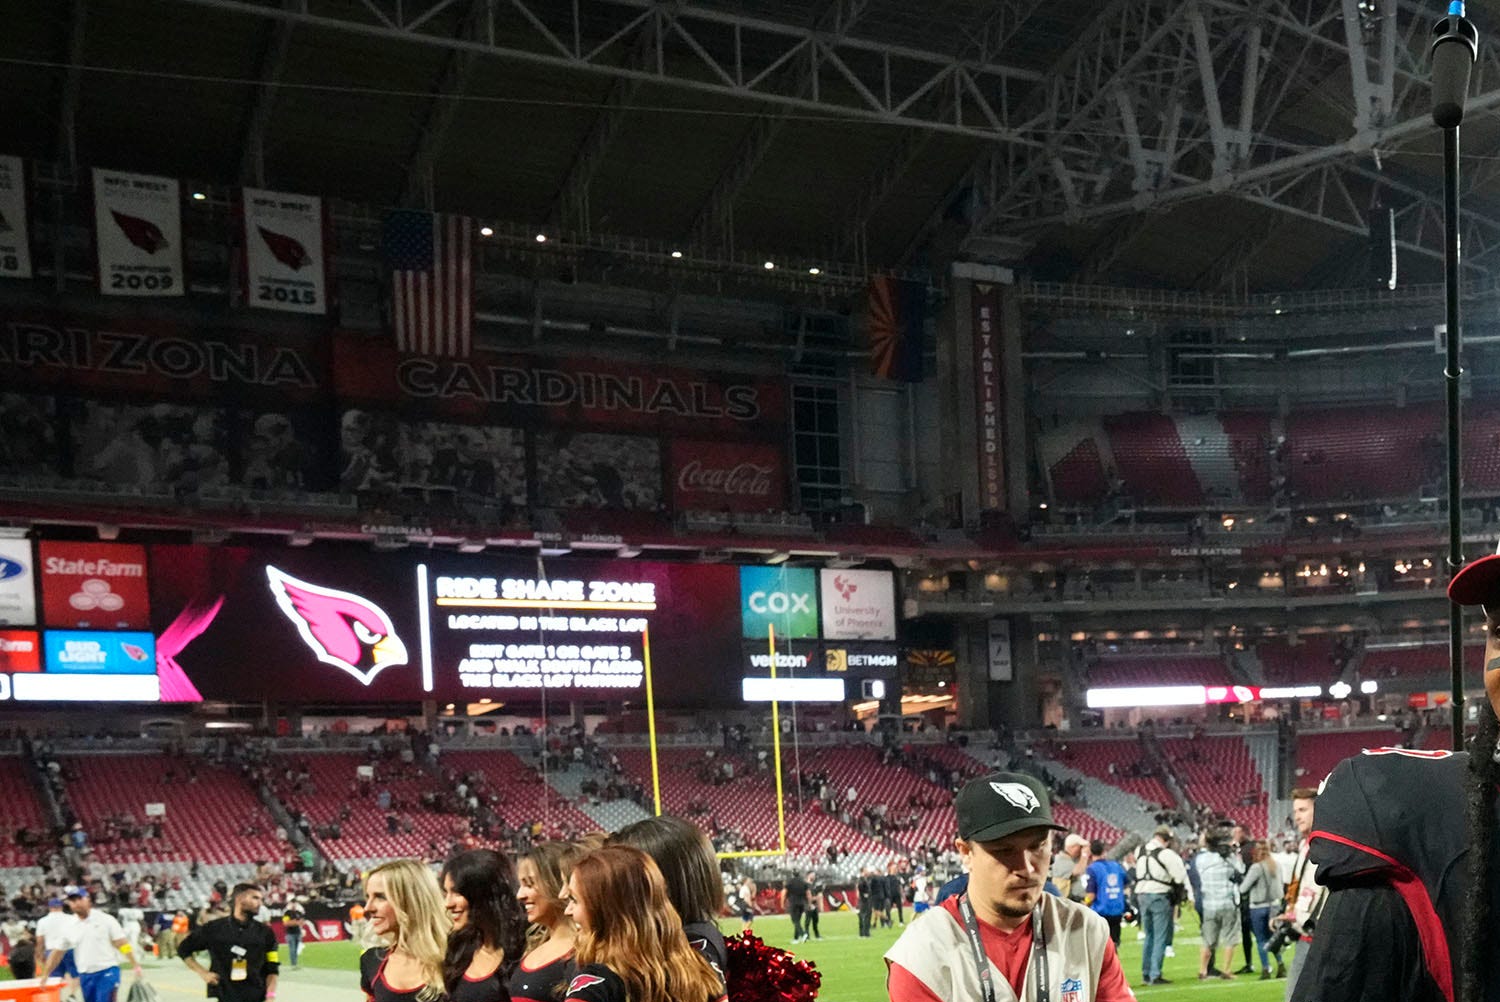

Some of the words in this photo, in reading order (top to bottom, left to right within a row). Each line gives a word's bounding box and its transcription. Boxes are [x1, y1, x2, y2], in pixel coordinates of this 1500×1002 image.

[111, 273, 173, 290] 2009
[259, 286, 316, 305] 2015
[395, 358, 761, 421] CARDINALS
[677, 459, 774, 497] Coca-Cola
[361, 524, 433, 536] CARDINALS
[1200, 547, 1242, 557] MATSON
[436, 577, 497, 599] RIDE
[501, 579, 585, 601] SHARE
[588, 581, 656, 603] ZONE
[749, 591, 810, 614] COX
[834, 605, 880, 618] University
[448, 615, 518, 630] LOCATED
[519, 616, 538, 631] IN
[538, 616, 569, 631] THE
[569, 617, 618, 632] BLACK
[618, 618, 648, 632] LOT
[847, 618, 883, 629] Phoenix
[847, 654, 898, 667] BETMGM
